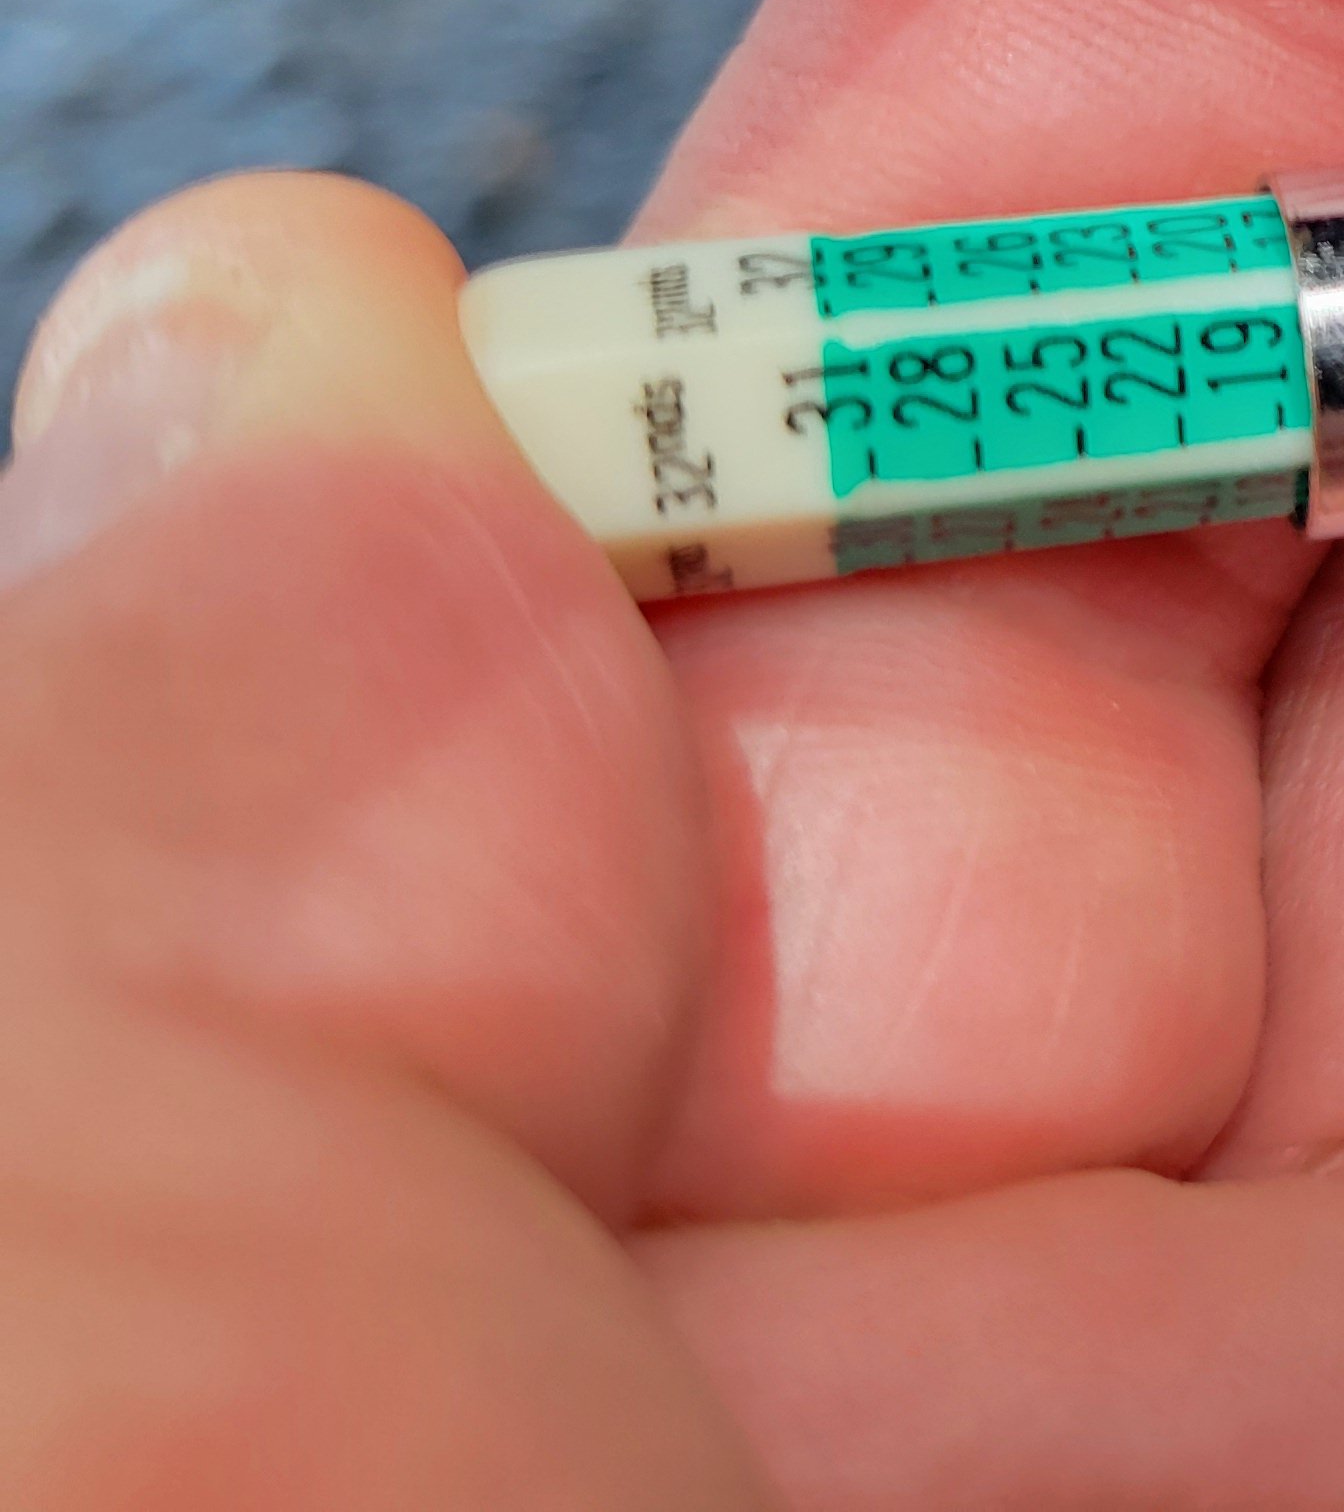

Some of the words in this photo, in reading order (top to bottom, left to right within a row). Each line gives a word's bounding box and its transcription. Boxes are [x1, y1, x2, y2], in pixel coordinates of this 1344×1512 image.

[842, 243, 932, 288] 29
[953, 230, 1044, 278] 26
[1049, 222, 1138, 268] 23
[1147, 213, 1236, 258] 20
[889, 345, 980, 429] 28
[1004, 333, 1090, 416] 25
[1101, 322, 1186, 405] 22
[1200, 317, 1289, 391] 19
[782, 355, 874, 436] 31
